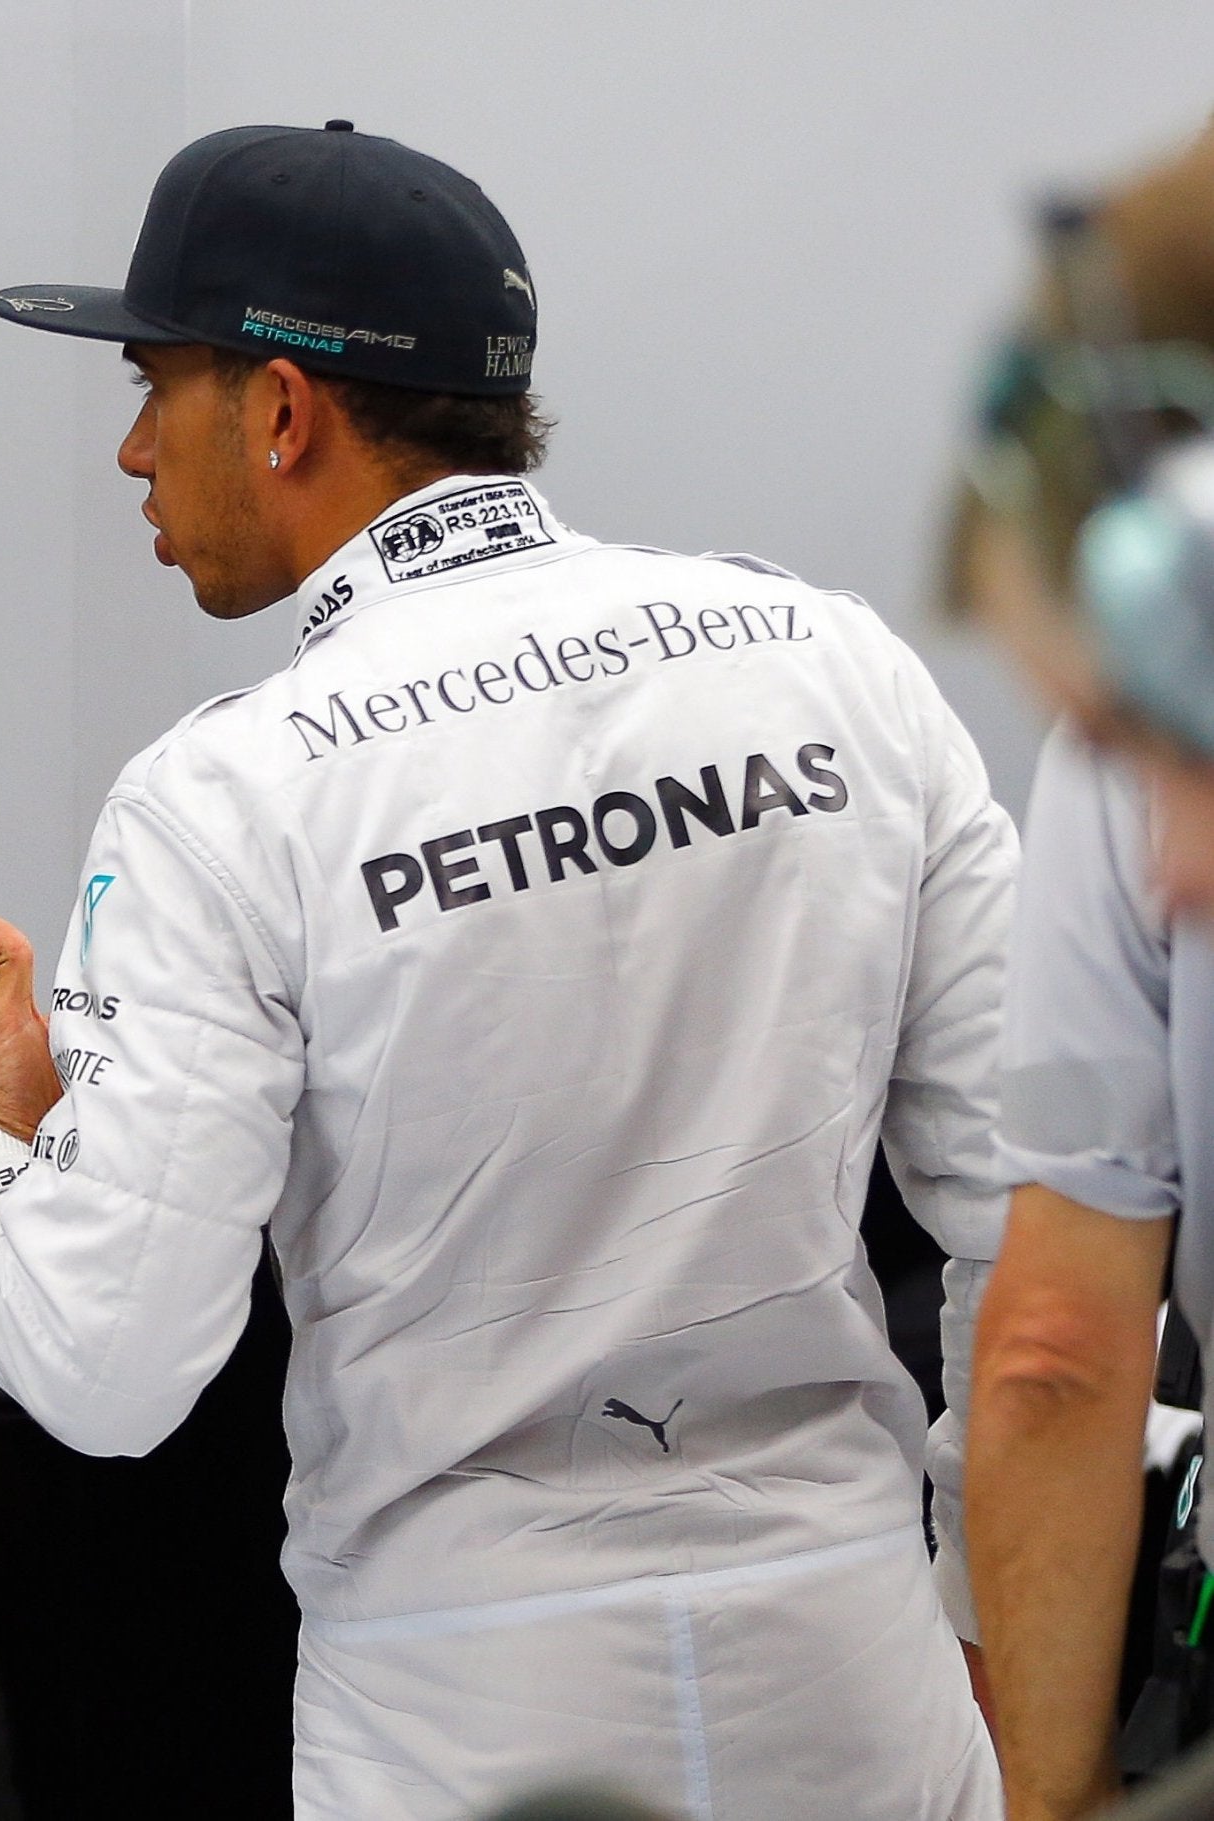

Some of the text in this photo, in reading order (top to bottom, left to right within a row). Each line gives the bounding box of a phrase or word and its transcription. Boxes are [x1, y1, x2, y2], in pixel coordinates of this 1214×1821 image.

[242, 320, 344, 353] PETRONAS
[245, 307, 346, 339] MERCEDES
[445, 501, 535, 534] RS.223.12
[384, 518, 443, 562] FIA
[284, 601, 813, 761] Mercedes-Benz
[360, 743, 849, 933] PETRONAS
